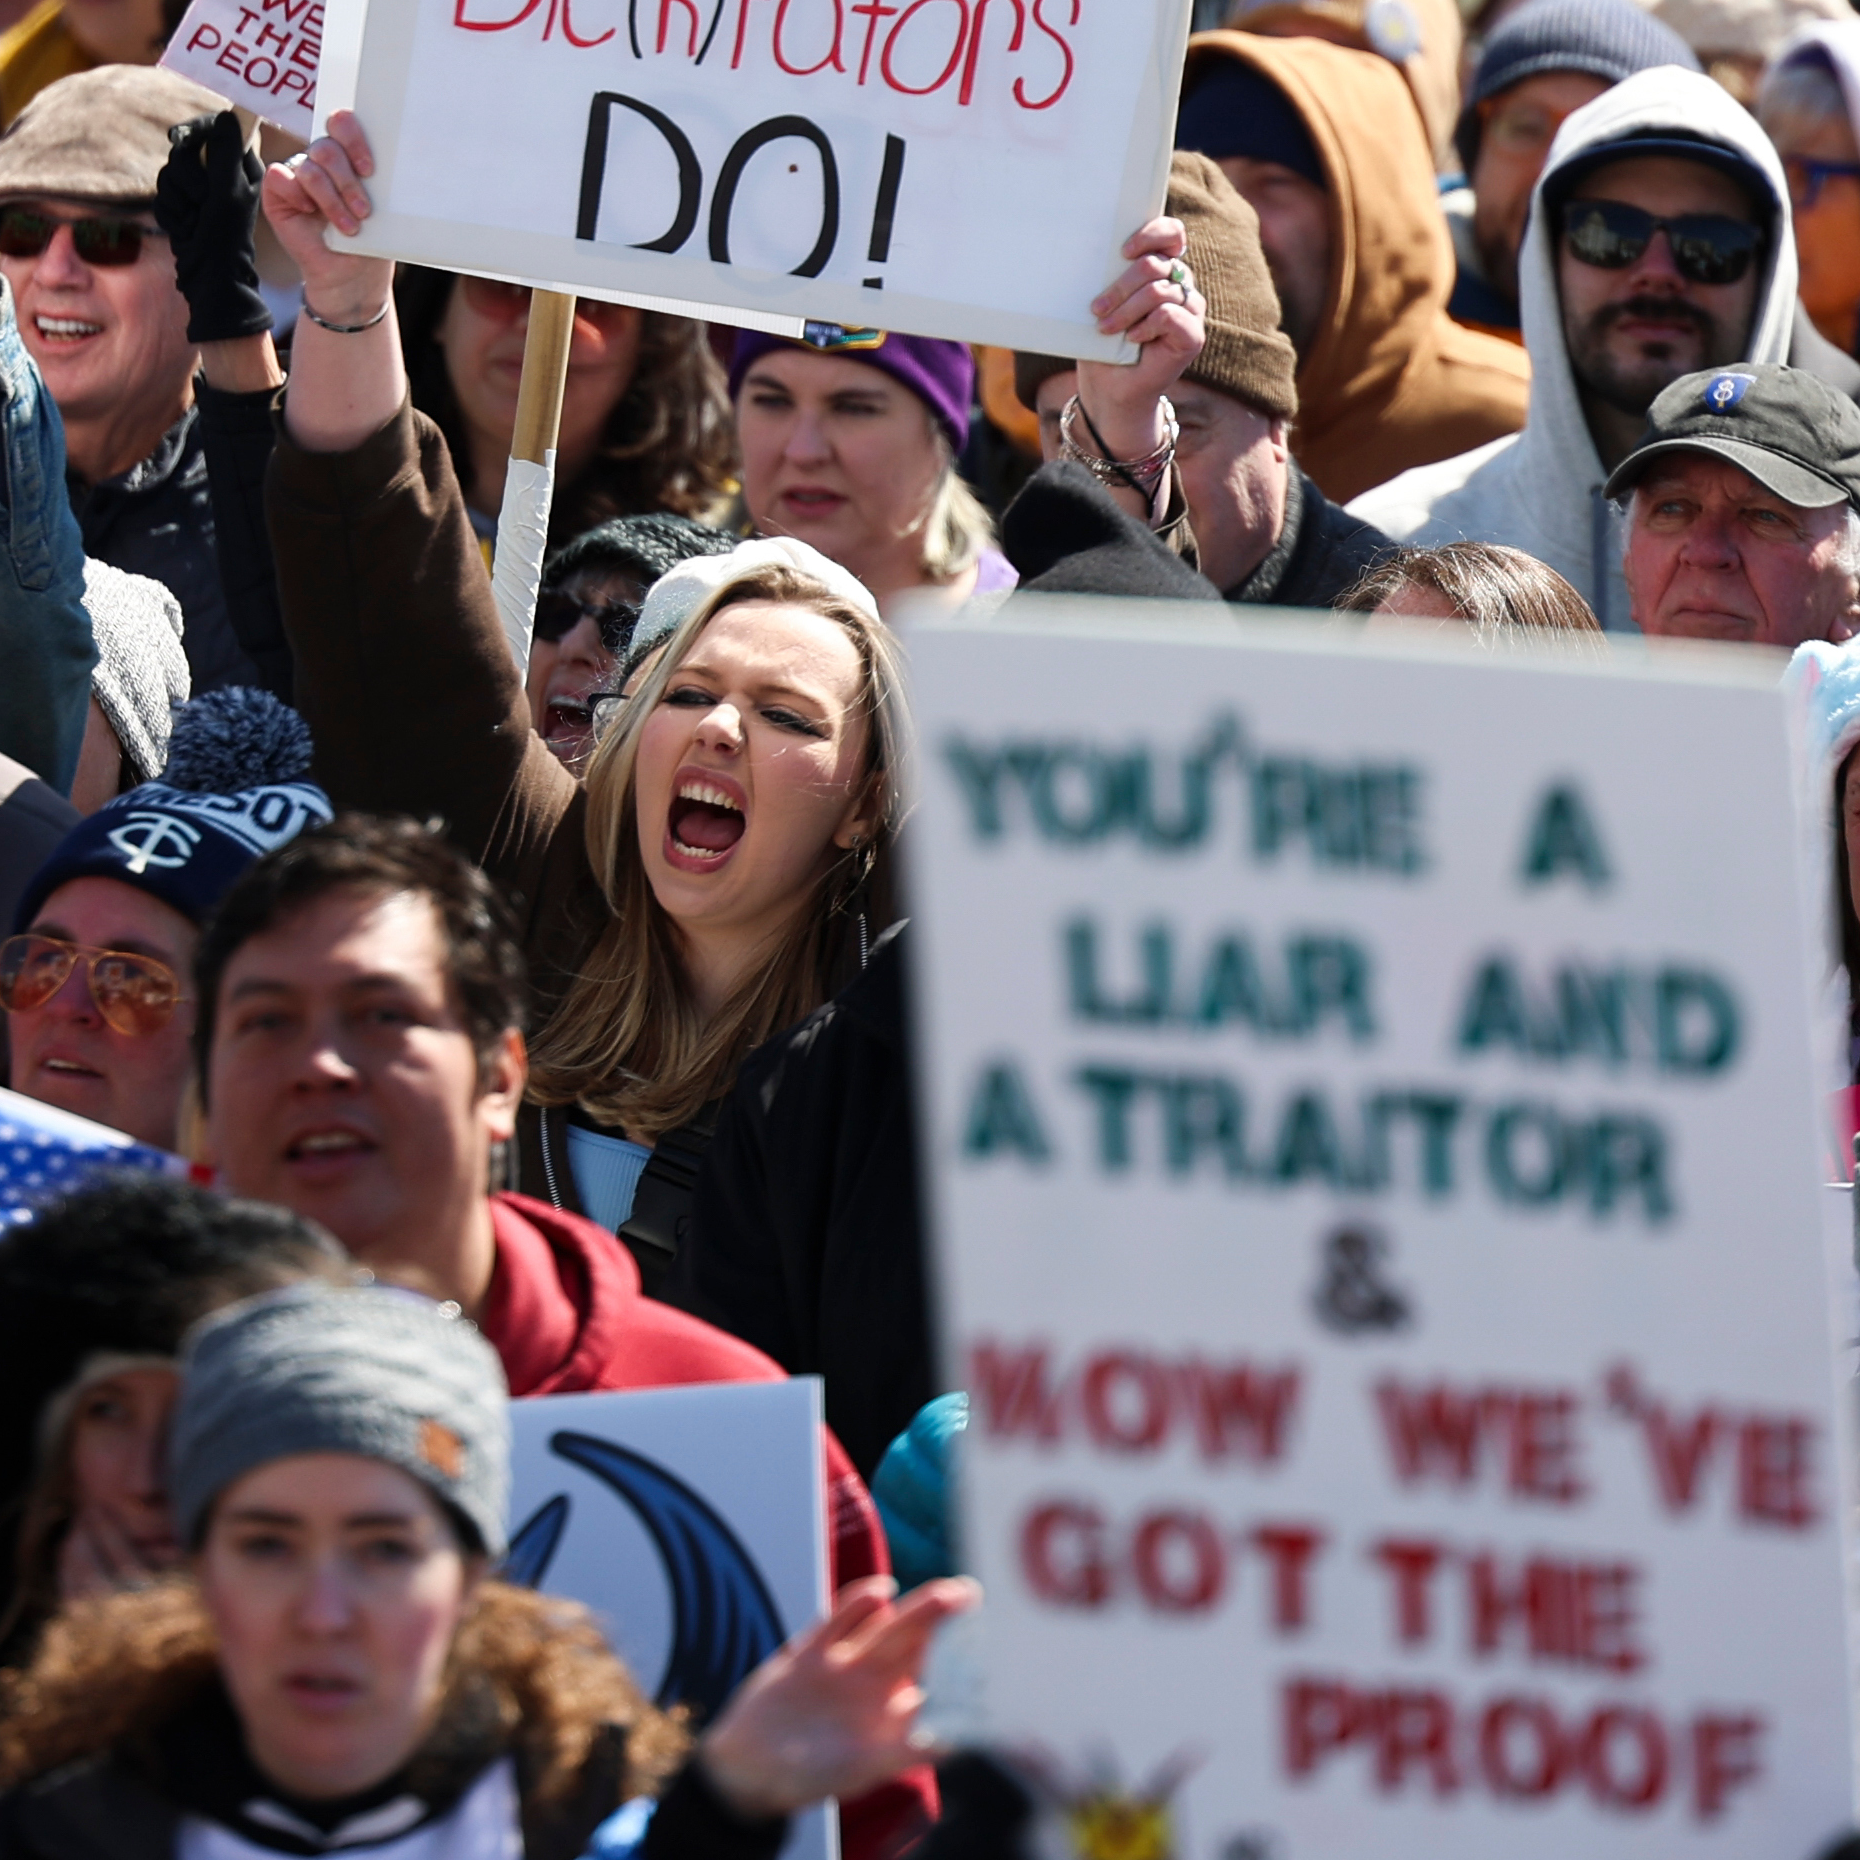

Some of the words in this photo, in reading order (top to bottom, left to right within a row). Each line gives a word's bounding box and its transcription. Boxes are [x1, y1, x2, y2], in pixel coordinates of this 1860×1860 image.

[186, 23, 316, 111] PEOPL
[234, 6, 321, 70] THE
[575, 89, 905, 290] DO!
[1519, 770, 1613, 893] A
[1062, 910, 1374, 1040] LIAR
[1459, 948, 1742, 1082] AND
[960, 1058, 1046, 1161] A
[1076, 1065, 1678, 1225] TRAITOR
[1312, 1223, 1410, 1335] &
[971, 1340, 1302, 1468] NOW
[1020, 1498, 1322, 1638] GOT
[1373, 1541, 1648, 1680] THE
[1282, 1680, 1766, 1823] PROOF
